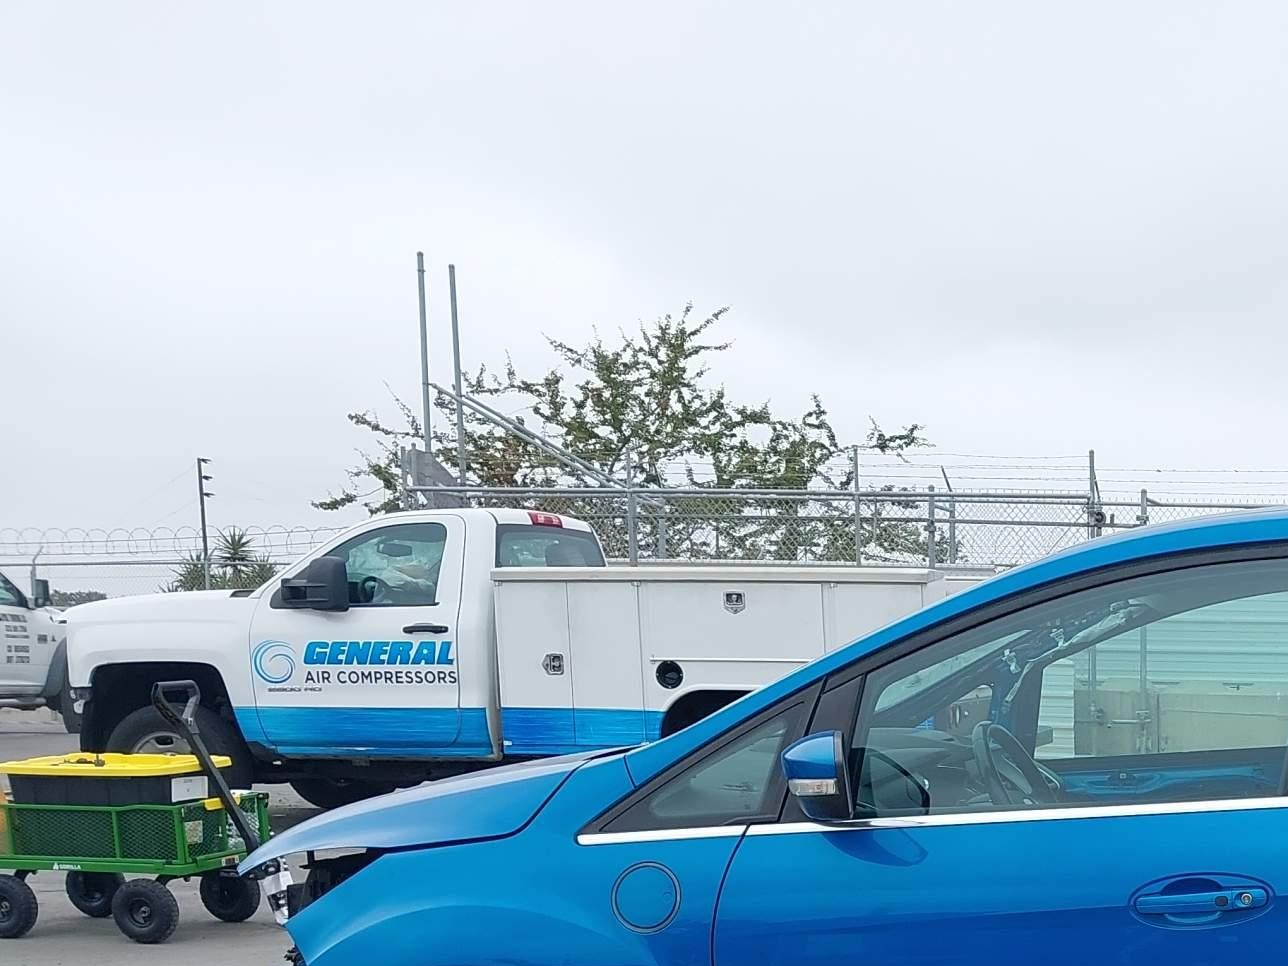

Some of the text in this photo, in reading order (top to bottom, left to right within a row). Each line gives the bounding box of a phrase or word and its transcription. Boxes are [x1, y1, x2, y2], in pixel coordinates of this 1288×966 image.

[303, 641, 456, 666] GENERAL
[305, 671, 457, 684] AIR COMPRESSORS
